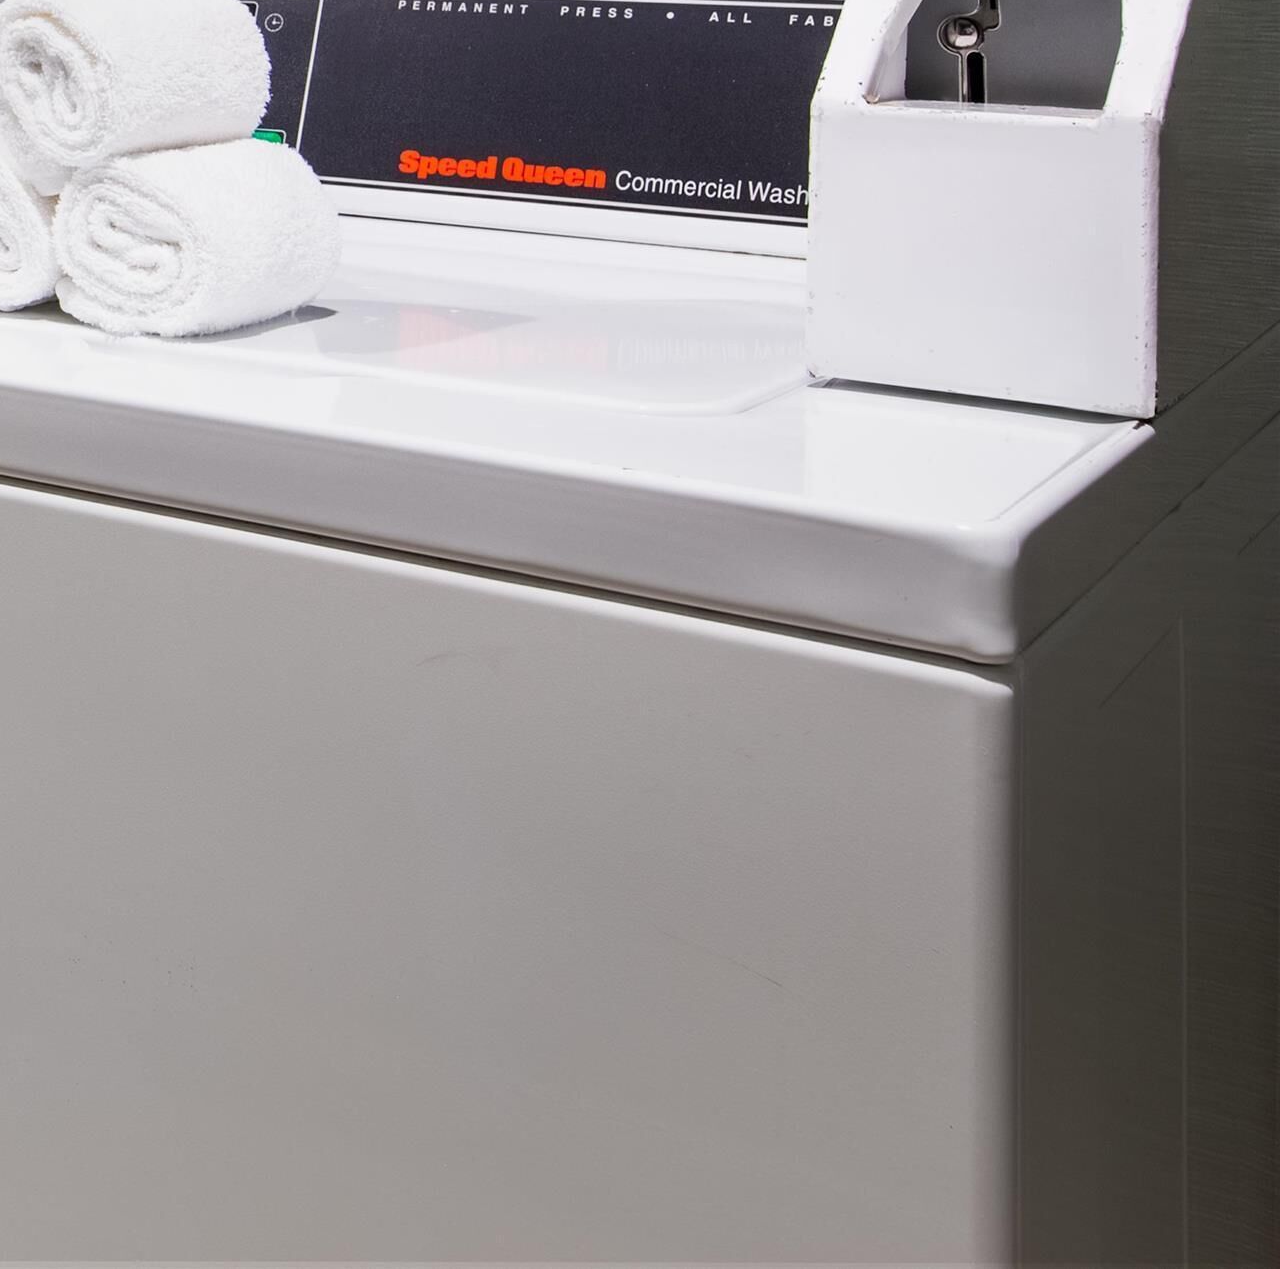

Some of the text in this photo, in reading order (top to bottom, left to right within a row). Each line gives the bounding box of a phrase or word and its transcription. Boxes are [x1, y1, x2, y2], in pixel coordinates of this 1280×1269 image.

[398, 0, 834, 27] PERMANENT PRESS ALL FAB
[398, 149, 809, 206] Speed Queen Commercial Wash
